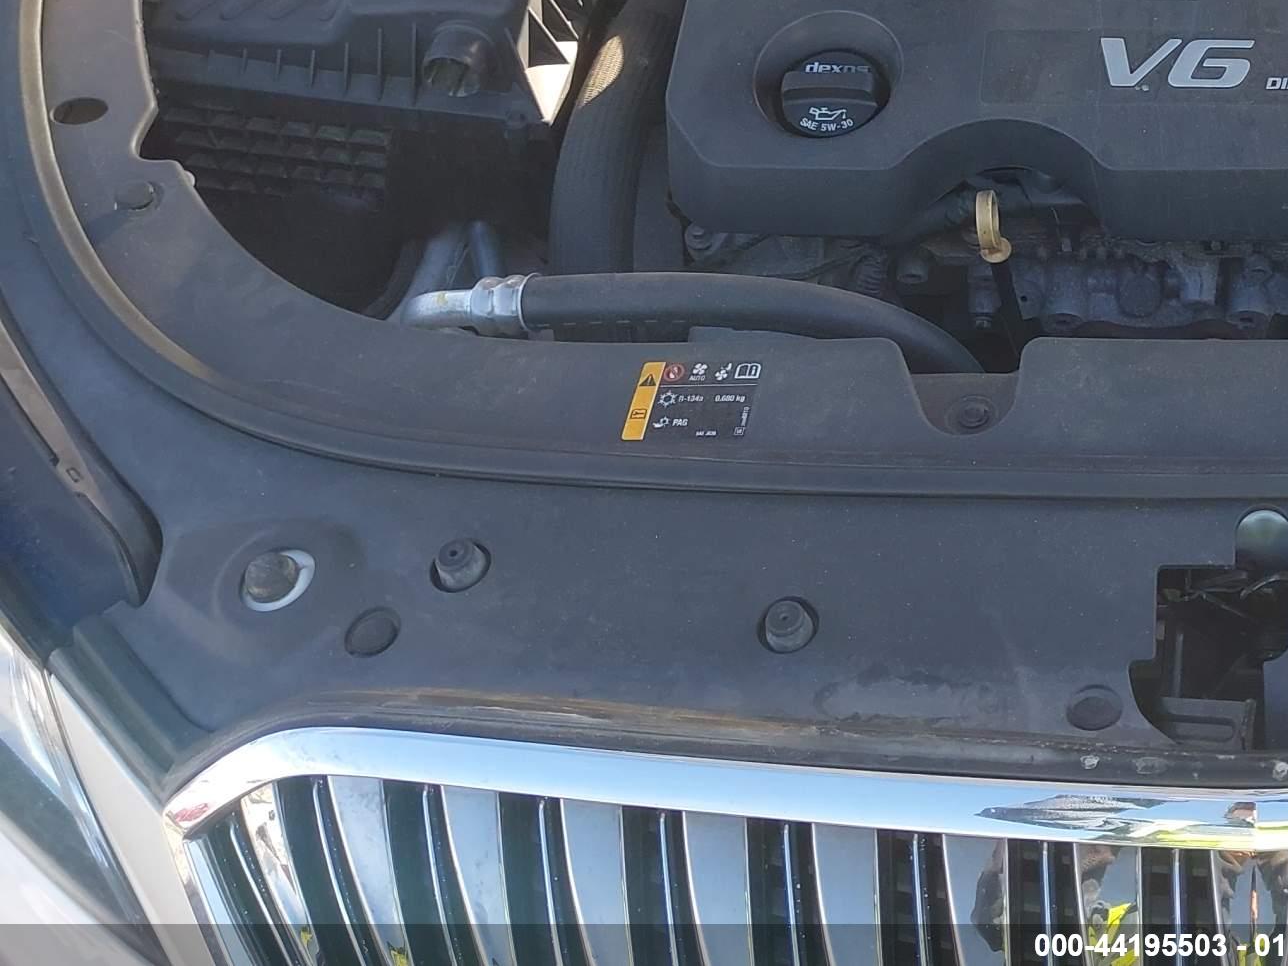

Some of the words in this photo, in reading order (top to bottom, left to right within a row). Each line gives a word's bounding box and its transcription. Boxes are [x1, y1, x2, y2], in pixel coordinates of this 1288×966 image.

[1101, 37, 1255, 89] V6
[799, 117, 818, 132] SAE
[820, 117, 854, 133] 5W-30
[736, 394, 746, 404] kg
[672, 418, 689, 427] PAG
